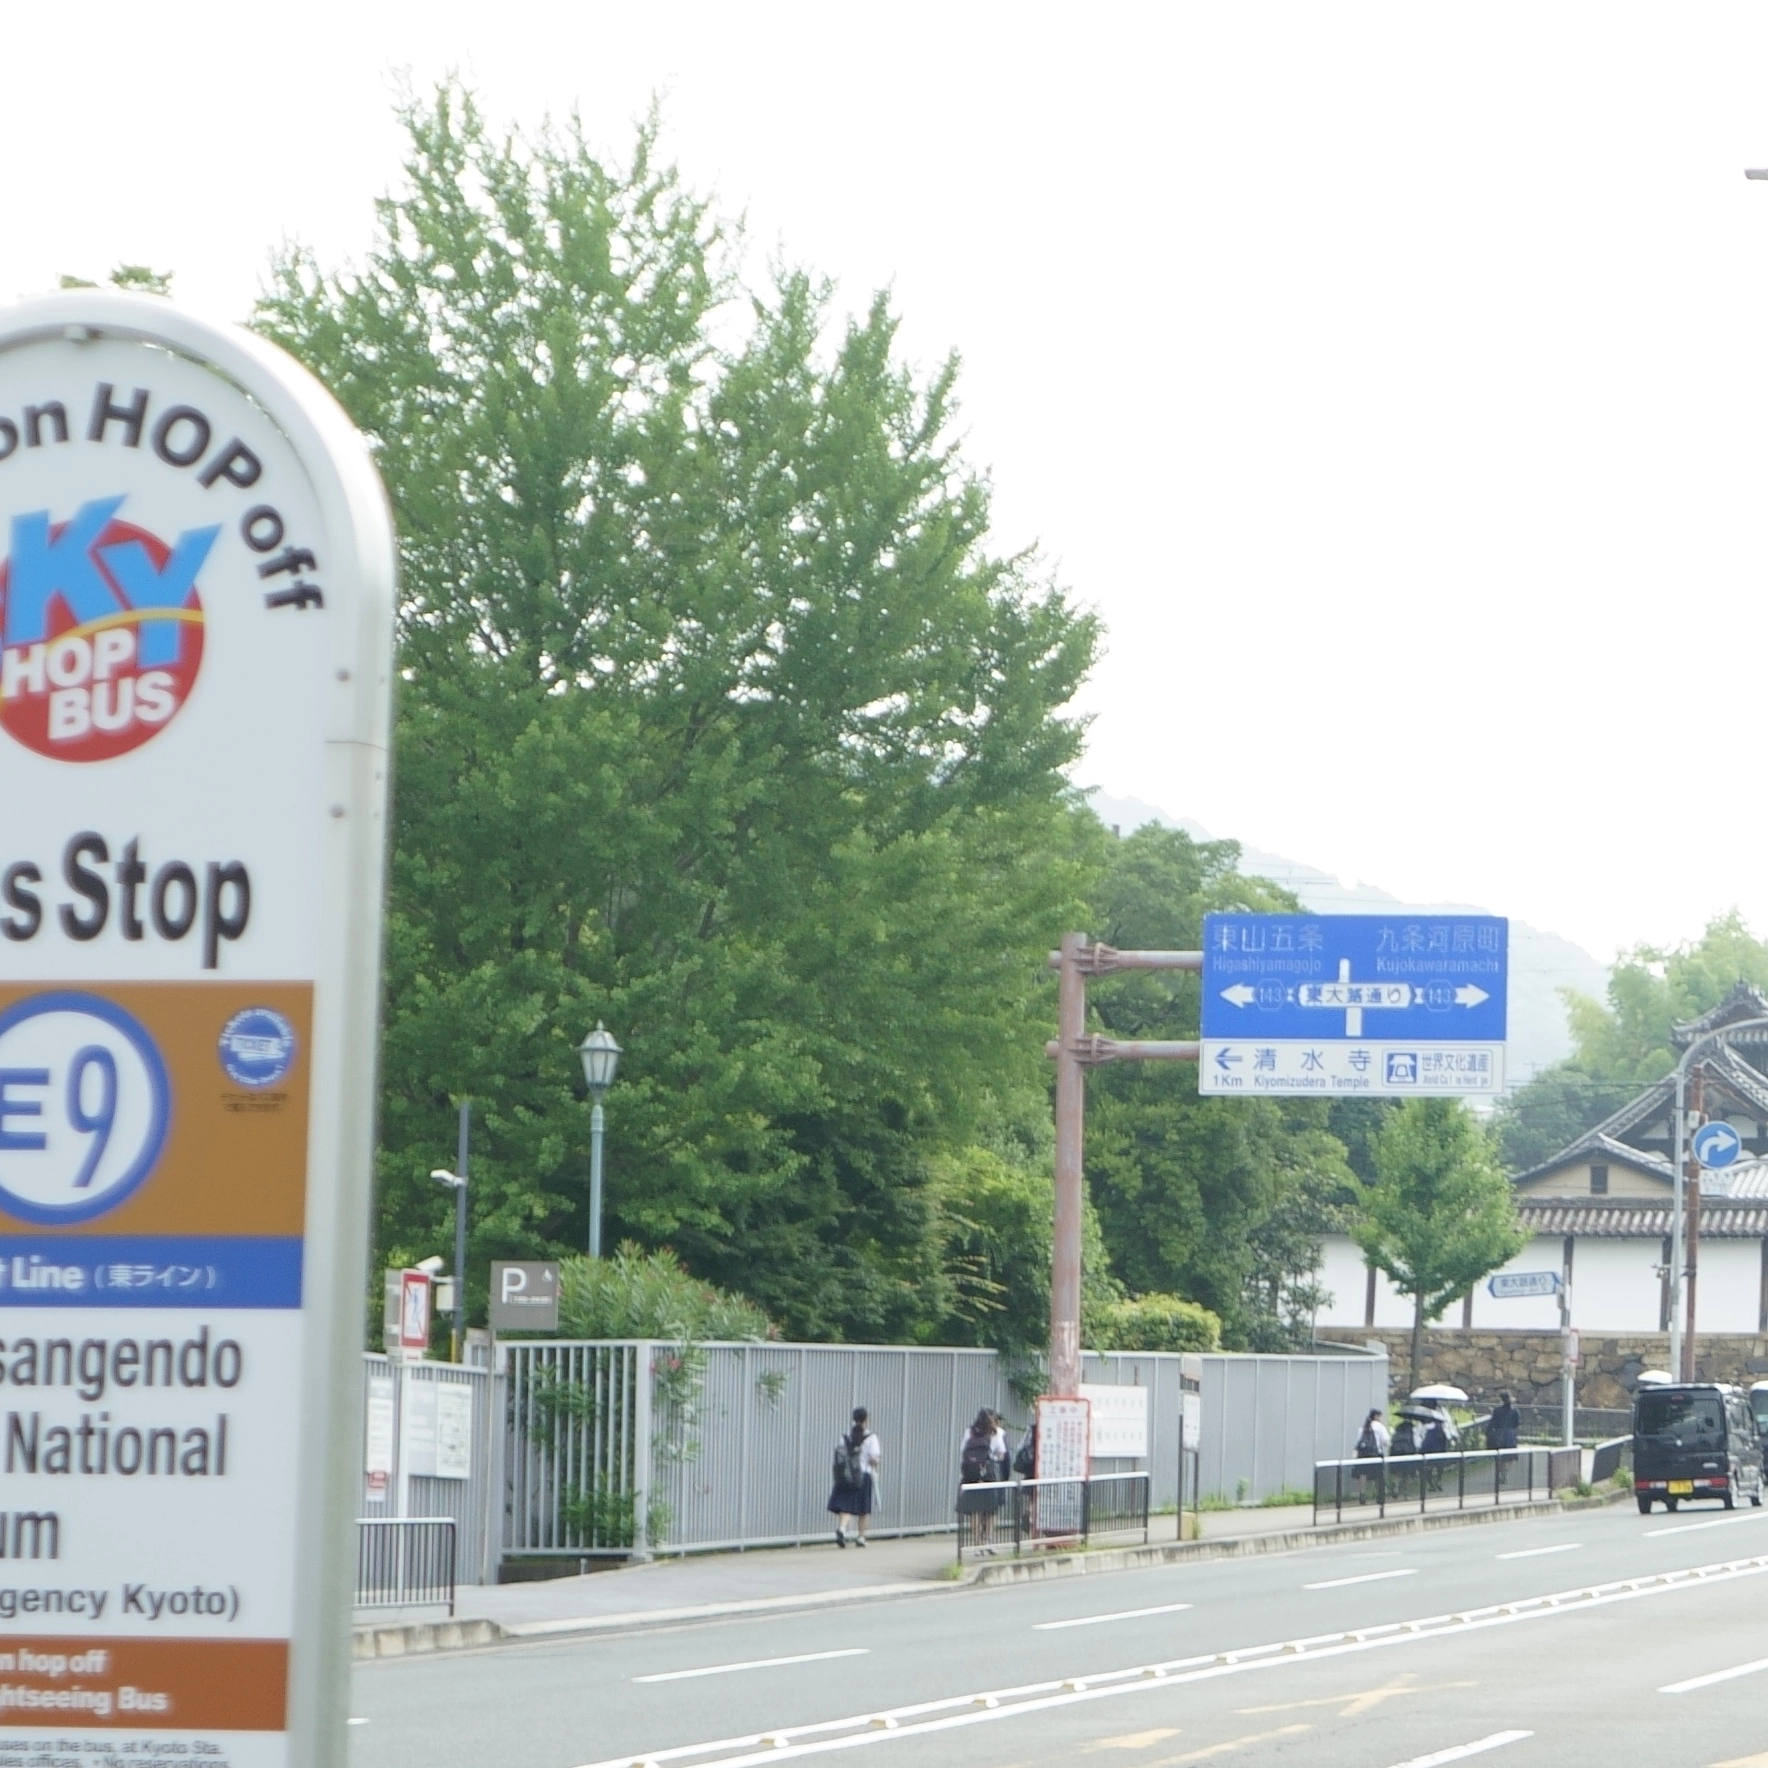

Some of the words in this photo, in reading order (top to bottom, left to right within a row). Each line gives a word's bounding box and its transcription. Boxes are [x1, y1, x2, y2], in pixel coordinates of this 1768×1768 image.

[86, 382, 262, 489] HOP
[240, 504, 324, 611] off
[1, 626, 136, 697] HOP
[49, 671, 175, 741] BUS
[57, 830, 251, 969] Stop
[1212, 924, 1323, 952] 東山五条
[1376, 924, 1500, 953] 九条河原町
[1213, 956, 1322, 974] Higashiyamagojo
[1377, 956, 1499, 975] Kujokawaramachi
[1260, 987, 1281, 1003] 143
[1306, 986, 1401, 1004] 東大路通り
[1429, 988, 1451, 1004] 143
[1253, 1047, 1372, 1072] 清水寺
[1422, 1052, 1488, 1072] 世界文化遺産
[1254, 1074, 1326, 1090] Kiyomizudera
[1330, 1075, 1370, 1091] Temple
[12, 1255, 83, 1290] Line
[501, 1267, 527, 1304] P
[4, 1410, 229, 1476] National
[122, 1583, 239, 1622] Kyoto)
[19, 1648, 68, 1677] hop
[69, 1650, 106, 1673] off
[119, 1687, 169, 1711] Bus
